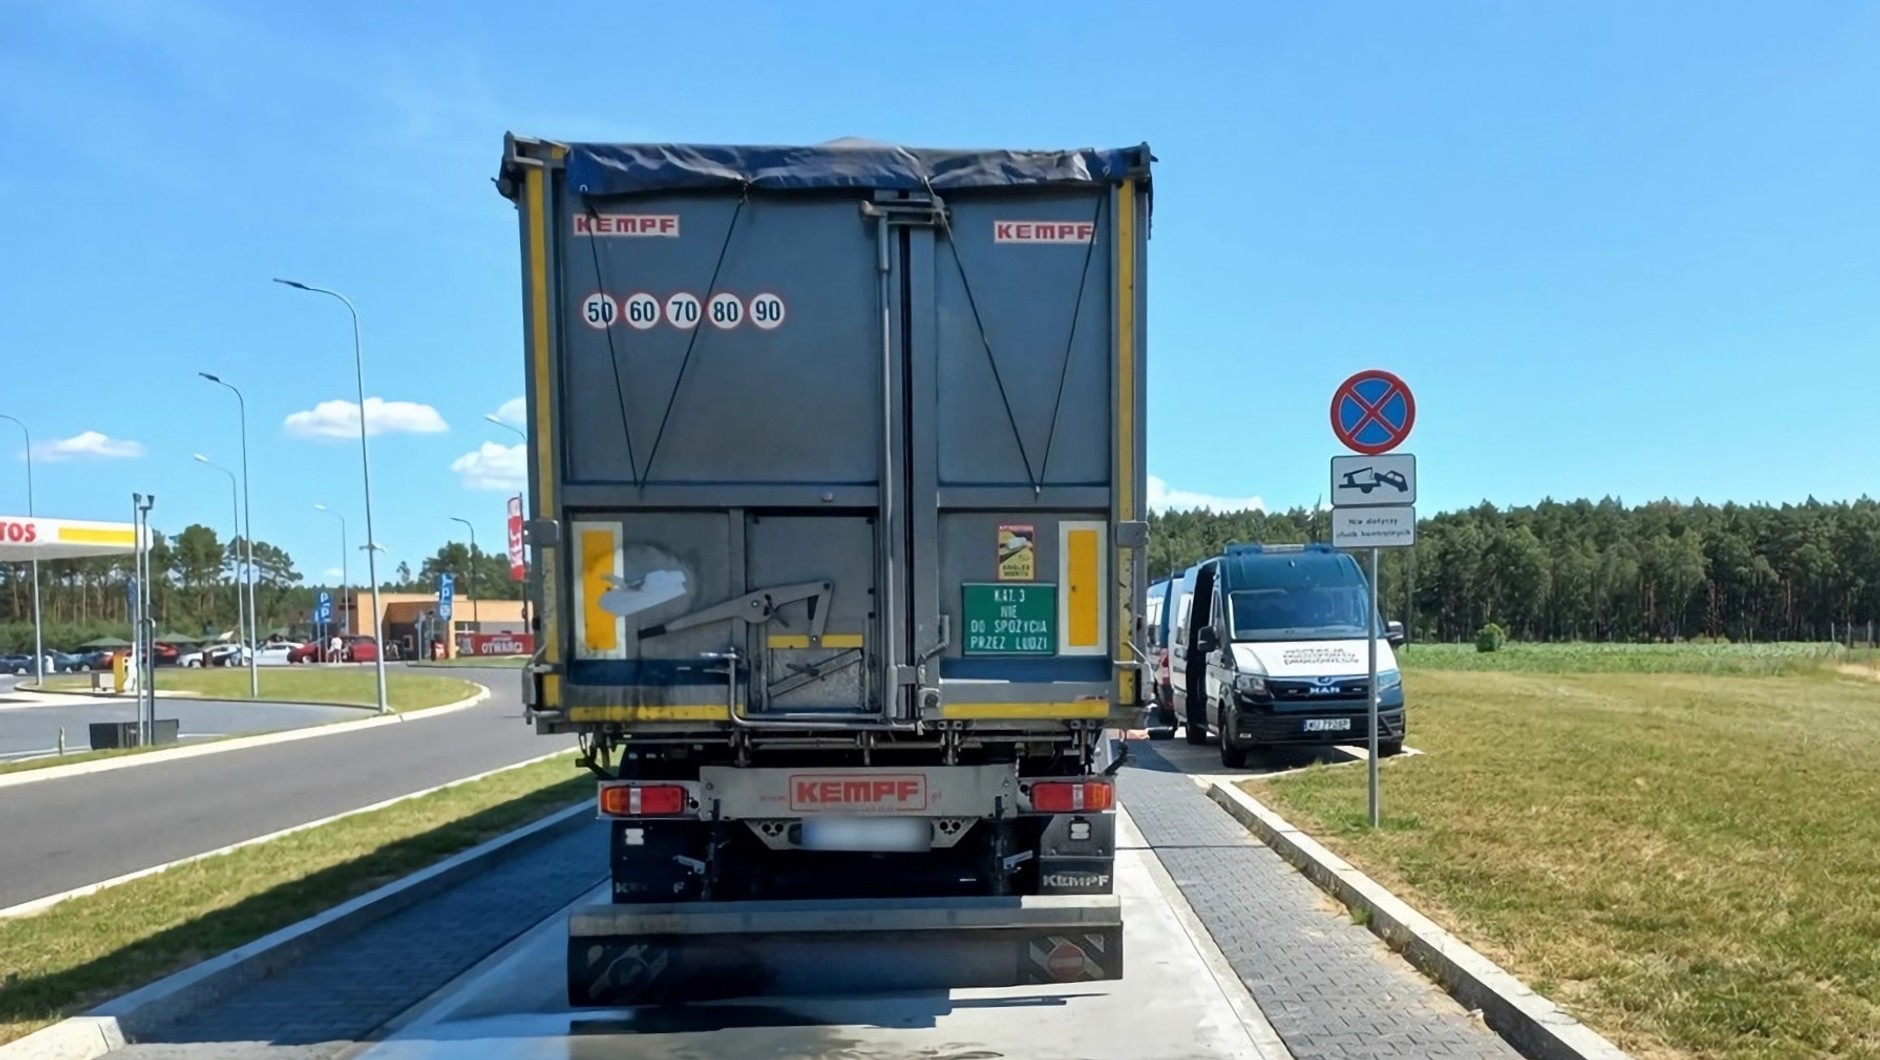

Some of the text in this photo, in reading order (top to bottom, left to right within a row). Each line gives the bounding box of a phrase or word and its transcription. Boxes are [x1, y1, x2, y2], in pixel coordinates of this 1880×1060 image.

[577, 217, 676, 233] KEMPF
[997, 224, 1093, 240] KEMPF
[588, 301, 613, 323] 50
[630, 301, 655, 322] 60
[671, 301, 698, 322] 70
[713, 301, 739, 322] 80
[755, 300, 781, 322] 90
[1018, 588, 1026, 603] 3
[1000, 604, 1018, 619] NIE
[970, 619, 986, 633] DO
[970, 635, 1047, 650] PRZEZ LUDZI
[796, 781, 919, 802] KEMPF
[1042, 874, 1110, 887] KEMPF
